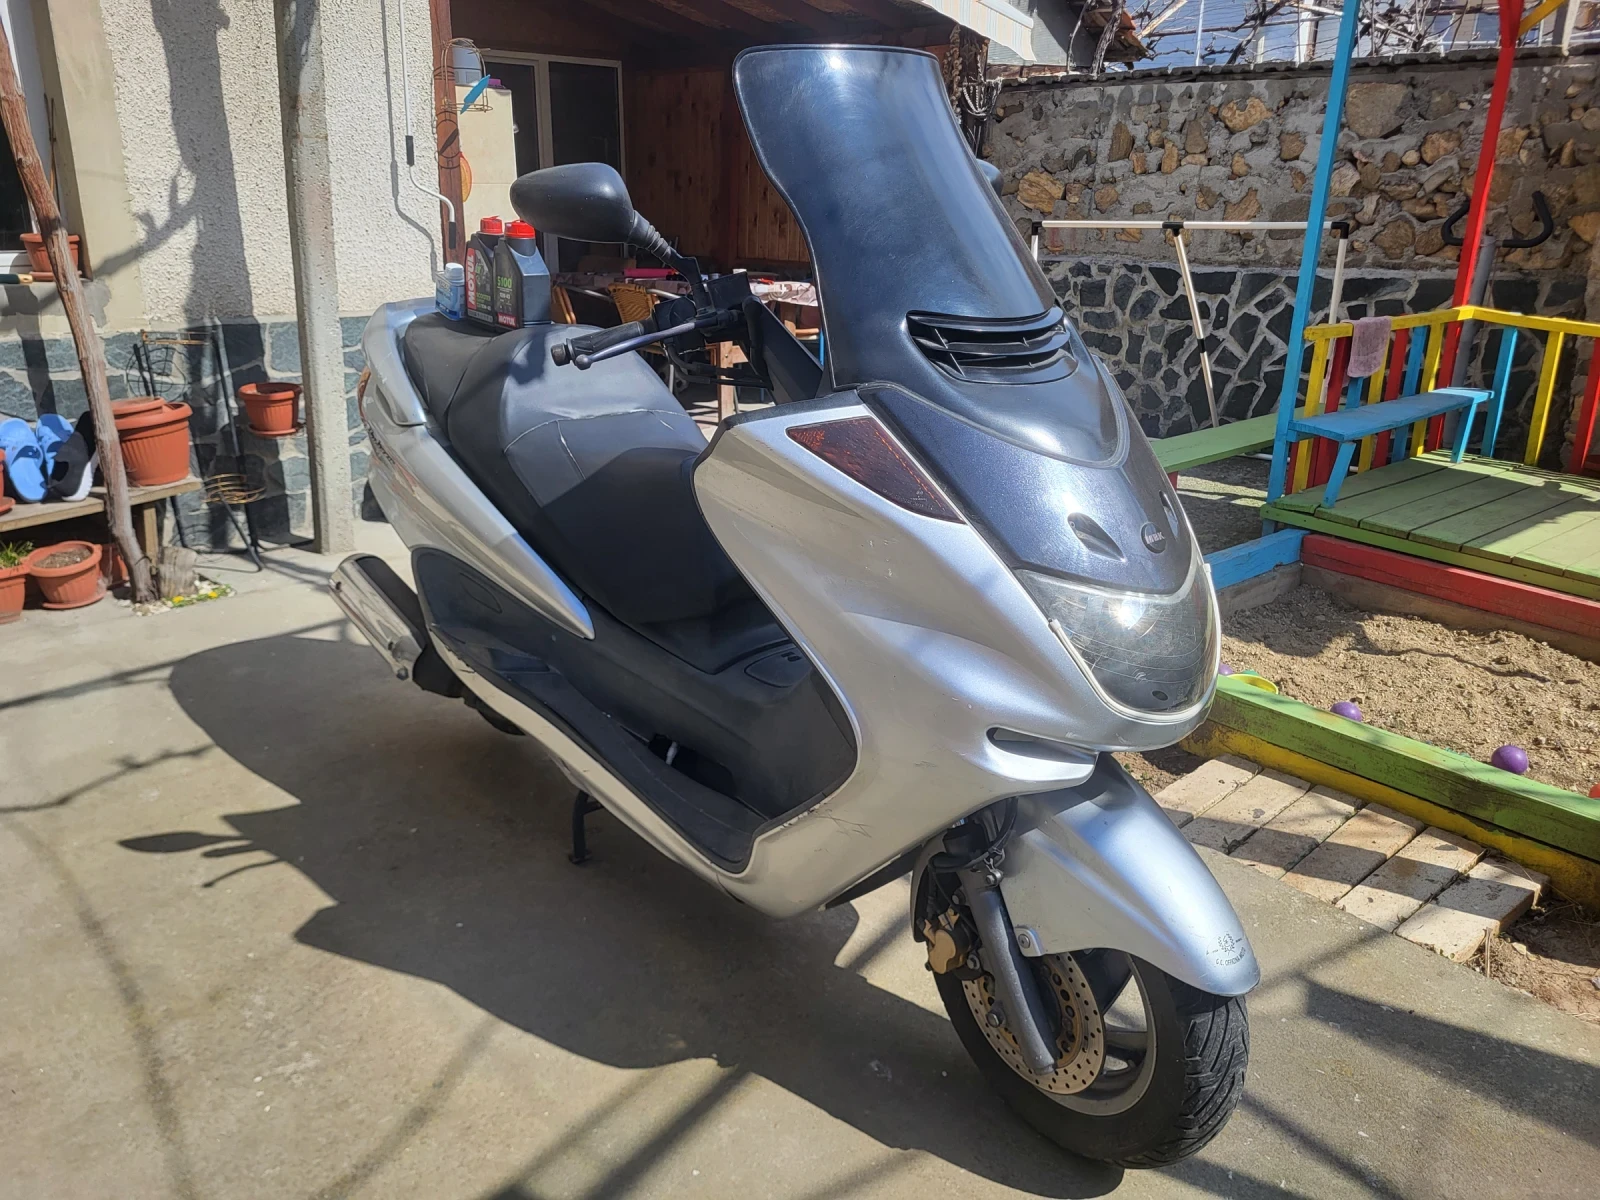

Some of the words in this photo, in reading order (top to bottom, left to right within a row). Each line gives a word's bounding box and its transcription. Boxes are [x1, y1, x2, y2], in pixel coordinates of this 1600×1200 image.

[497, 276, 512, 288] 5100
[498, 315, 515, 326] MOTUL
[1145, 531, 1165, 545] MBK
